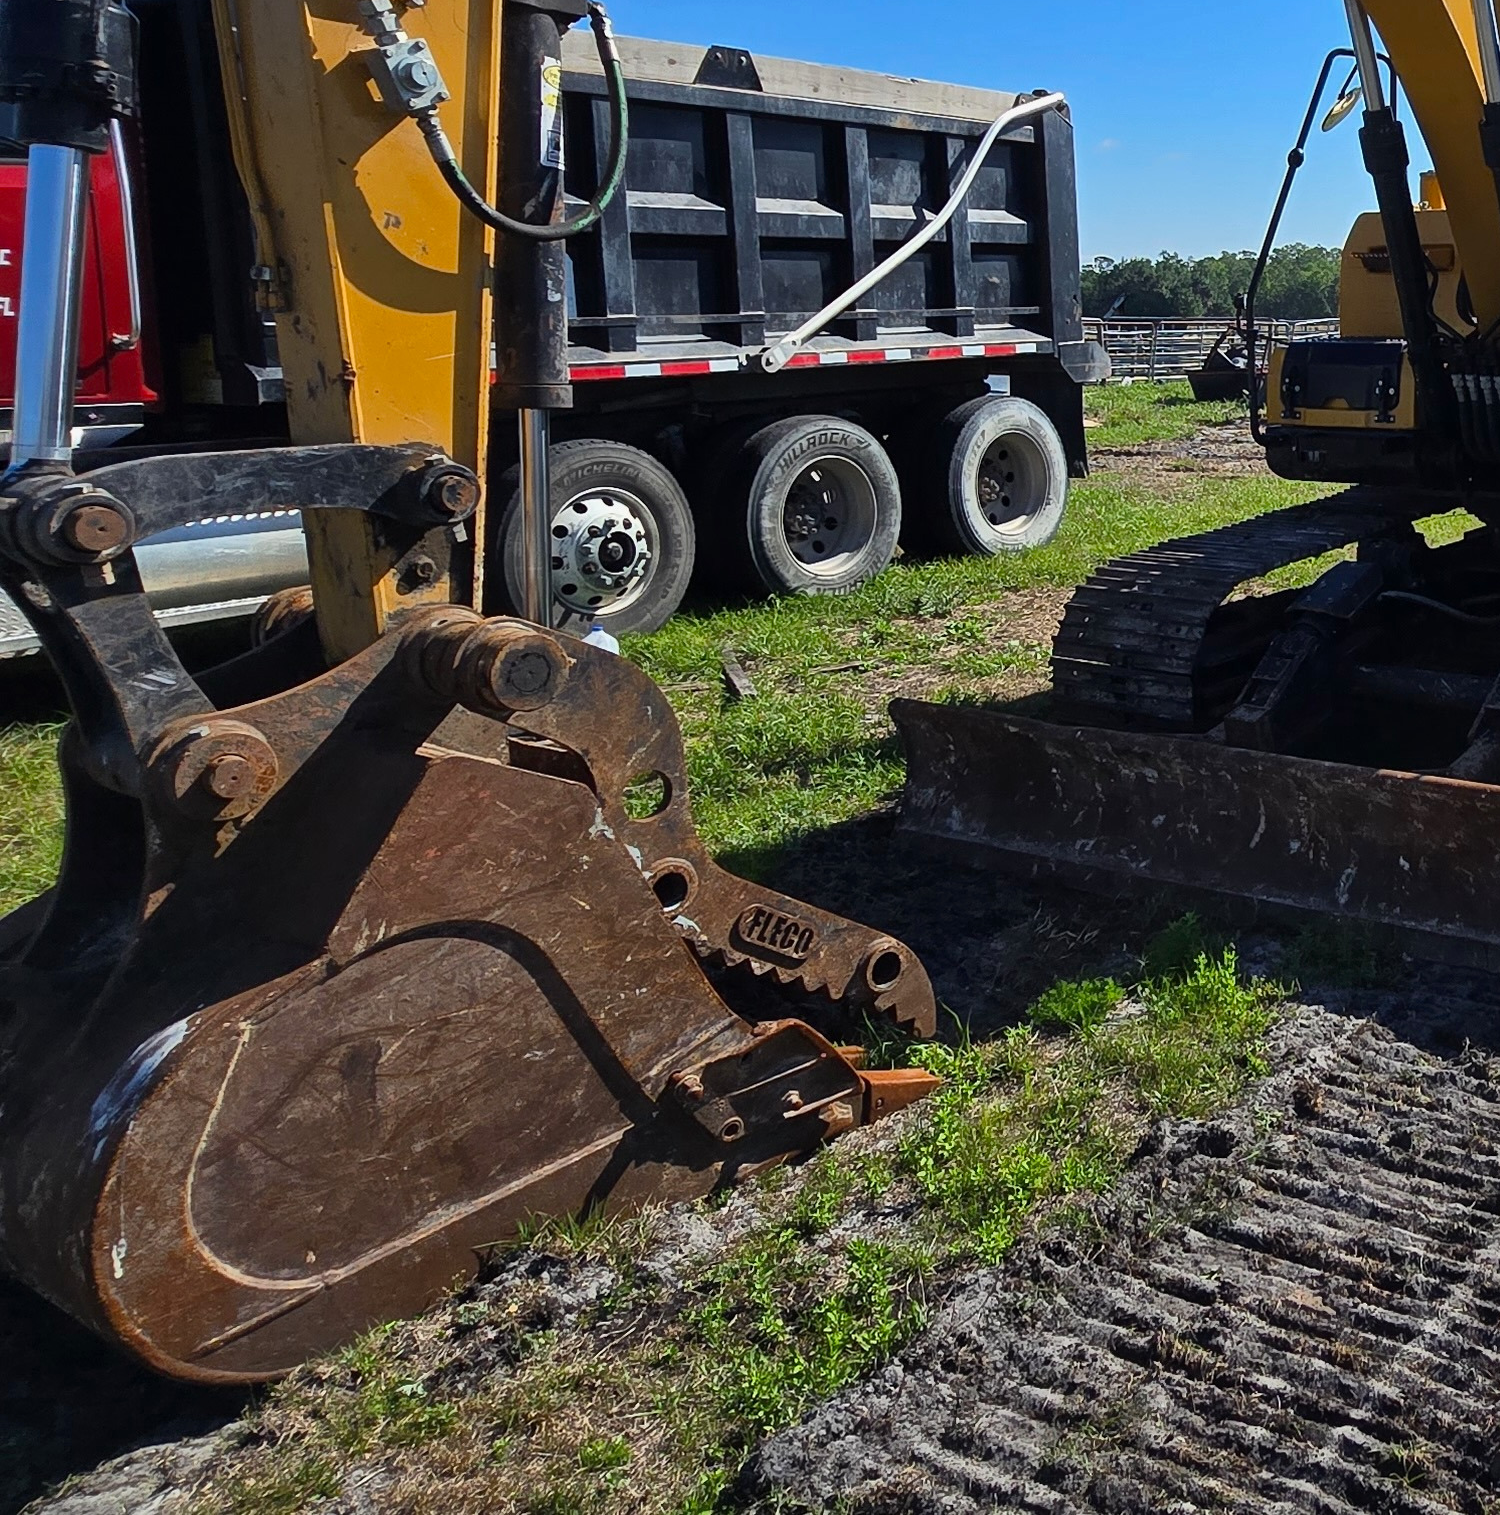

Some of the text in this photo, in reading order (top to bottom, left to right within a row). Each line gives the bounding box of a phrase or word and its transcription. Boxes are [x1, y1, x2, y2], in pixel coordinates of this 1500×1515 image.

[778, 432, 851, 474] HILLROCK
[562, 463, 640, 487] MICHELIN
[748, 907, 815, 956] FLECO
